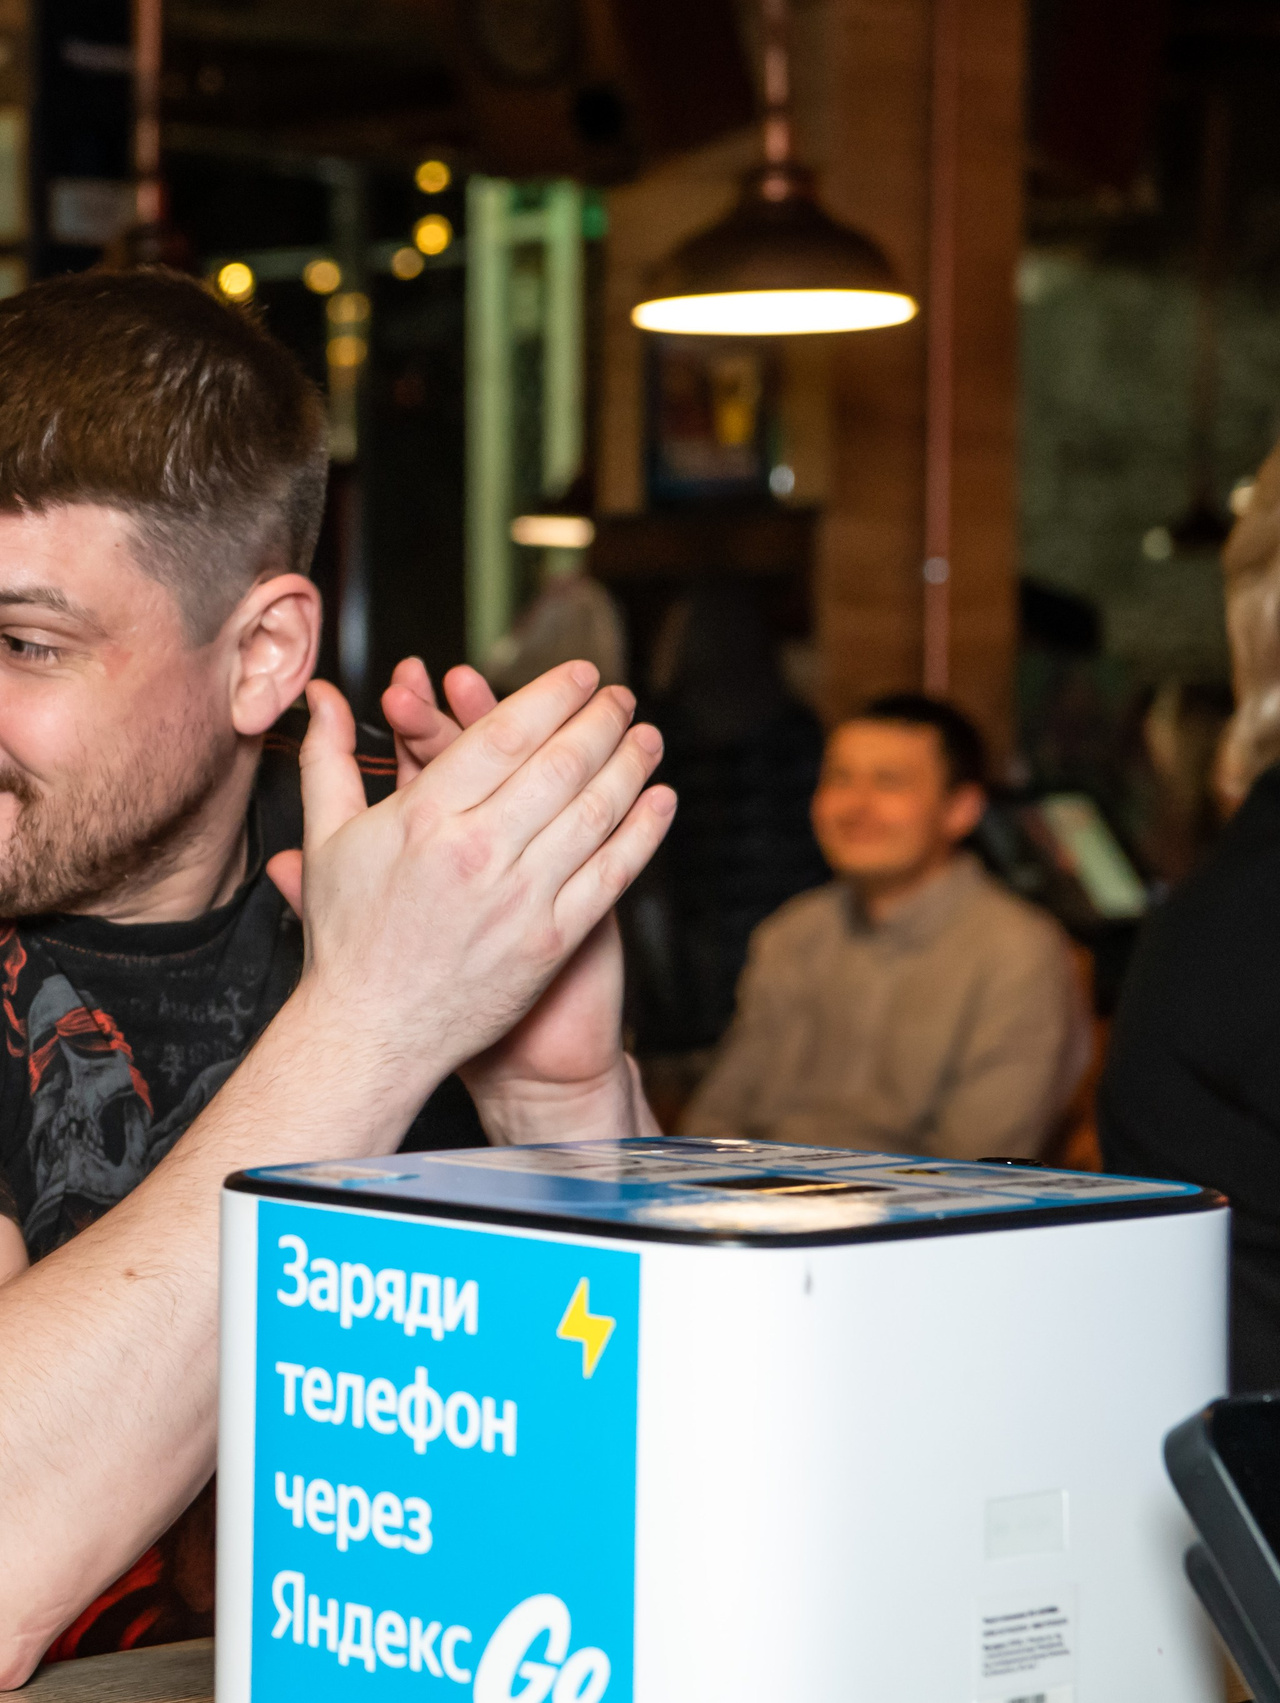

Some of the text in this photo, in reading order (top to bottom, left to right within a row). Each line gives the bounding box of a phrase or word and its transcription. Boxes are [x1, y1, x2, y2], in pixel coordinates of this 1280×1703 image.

[276, 1235, 479, 1341] Заряди
[275, 1361, 518, 1457] телефон
[274, 1471, 433, 1555] через
[271, 1570, 611, 1703] Яндекс Go
